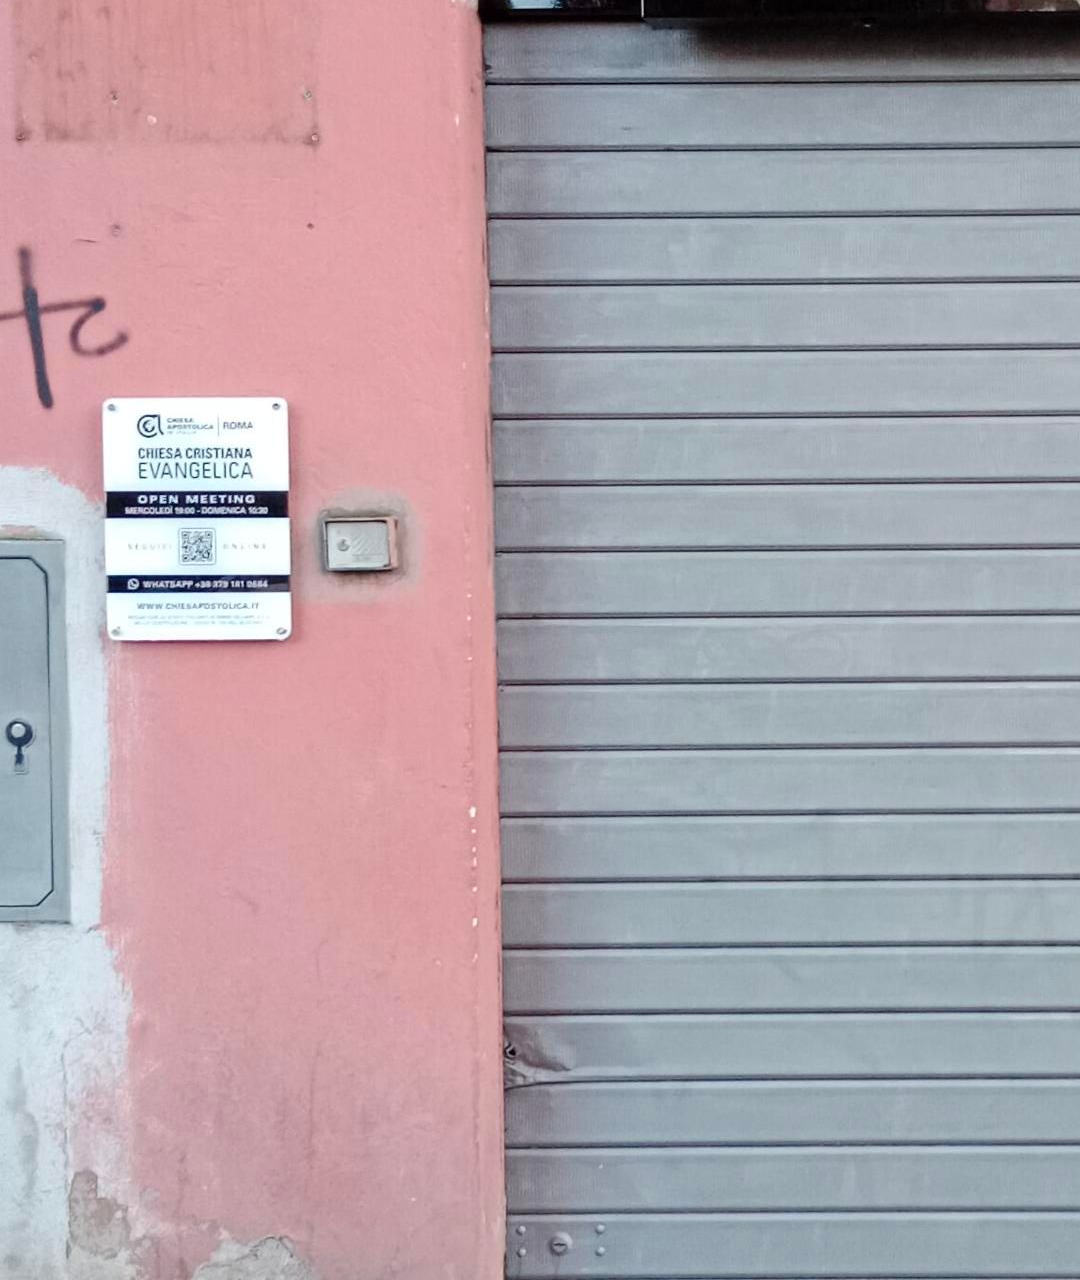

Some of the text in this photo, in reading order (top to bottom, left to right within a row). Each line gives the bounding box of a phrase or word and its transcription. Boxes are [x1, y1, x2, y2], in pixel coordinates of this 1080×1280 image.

[223, 421, 254, 430] ROMA
[138, 447, 253, 459] CHIESA CRISTIANA
[138, 462, 254, 479] EVANGELICA
[137, 494, 256, 504] OPEN MEETING
[201, 507, 247, 515] DOMENICA
[142, 580, 193, 590] WHATSAPP
